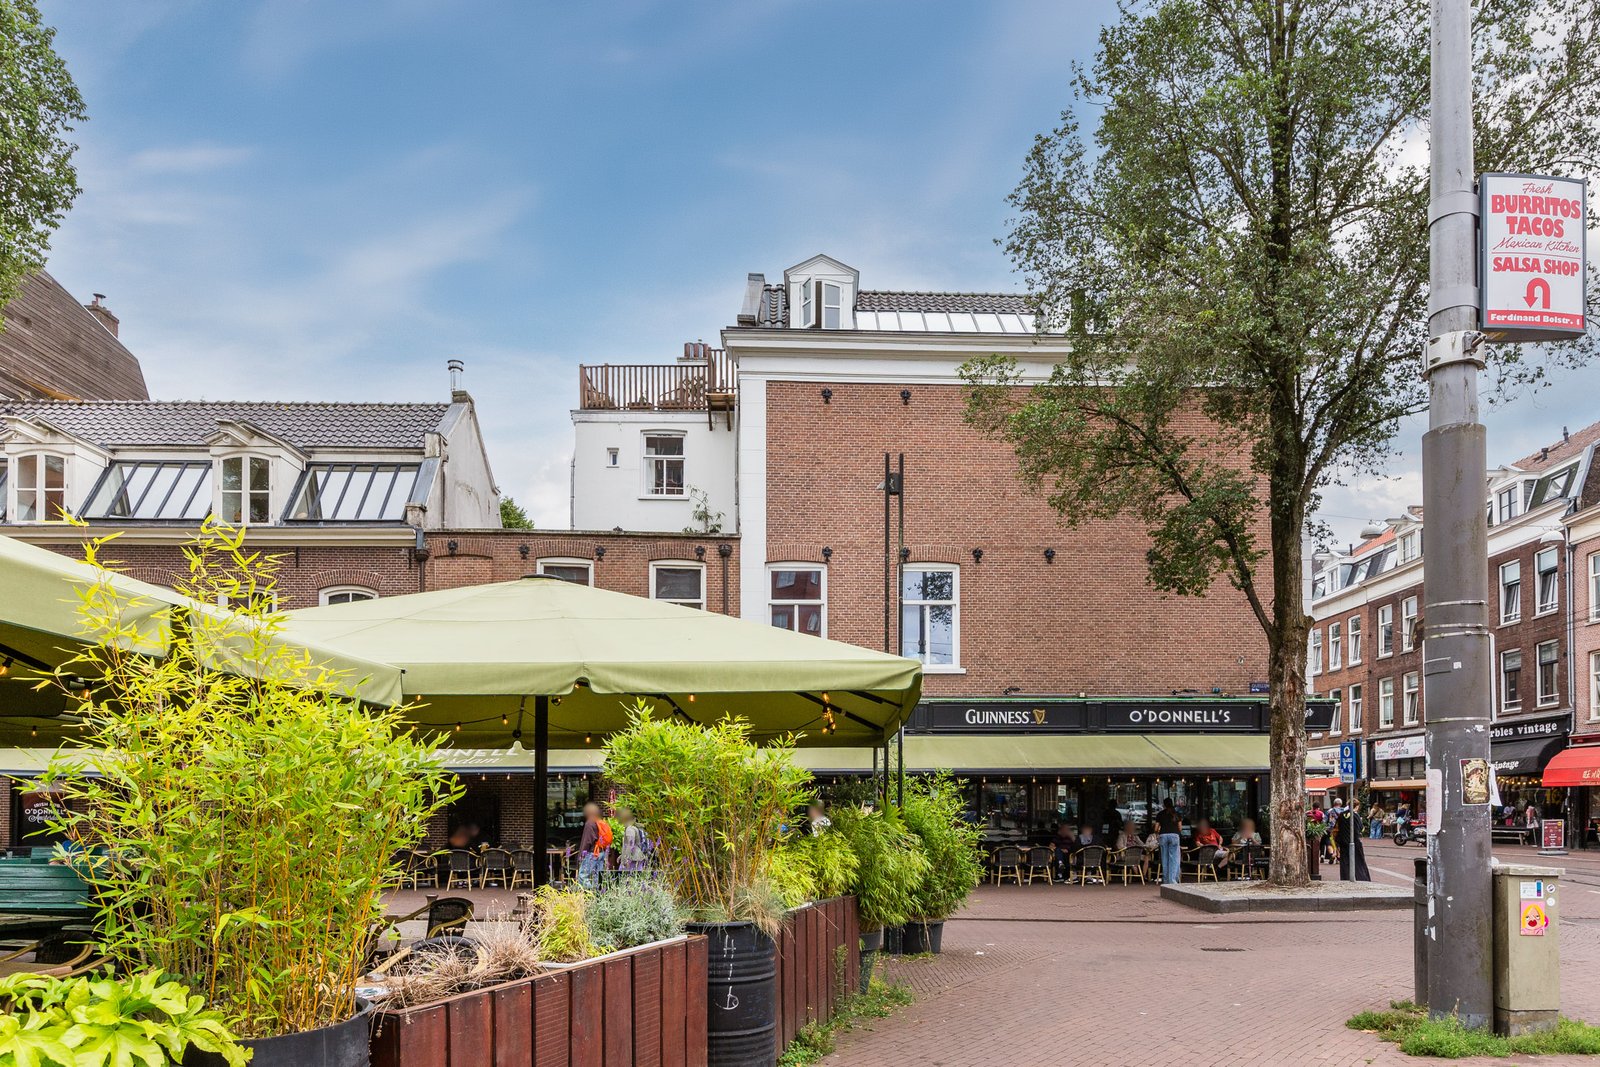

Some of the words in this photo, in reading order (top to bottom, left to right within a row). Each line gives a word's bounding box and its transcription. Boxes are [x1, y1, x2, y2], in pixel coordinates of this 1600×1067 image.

[1522, 182, 1553, 194] Fresh
[1491, 194, 1581, 219] BURRITOS
[1506, 216, 1564, 238] TACOS
[1493, 237, 1543, 250] Mexican
[1545, 240, 1580, 253] Kitchen
[1493, 257, 1541, 273] SALSA
[1543, 259, 1580, 276] SHOP
[1490, 313, 1541, 323] Ferdinand
[965, 709, 1030, 724] GUINNESS
[1129, 709, 1231, 723] O'DONNELL'S
[1490, 727, 1514, 738] rbles
[1517, 722, 1558, 734] vintage
